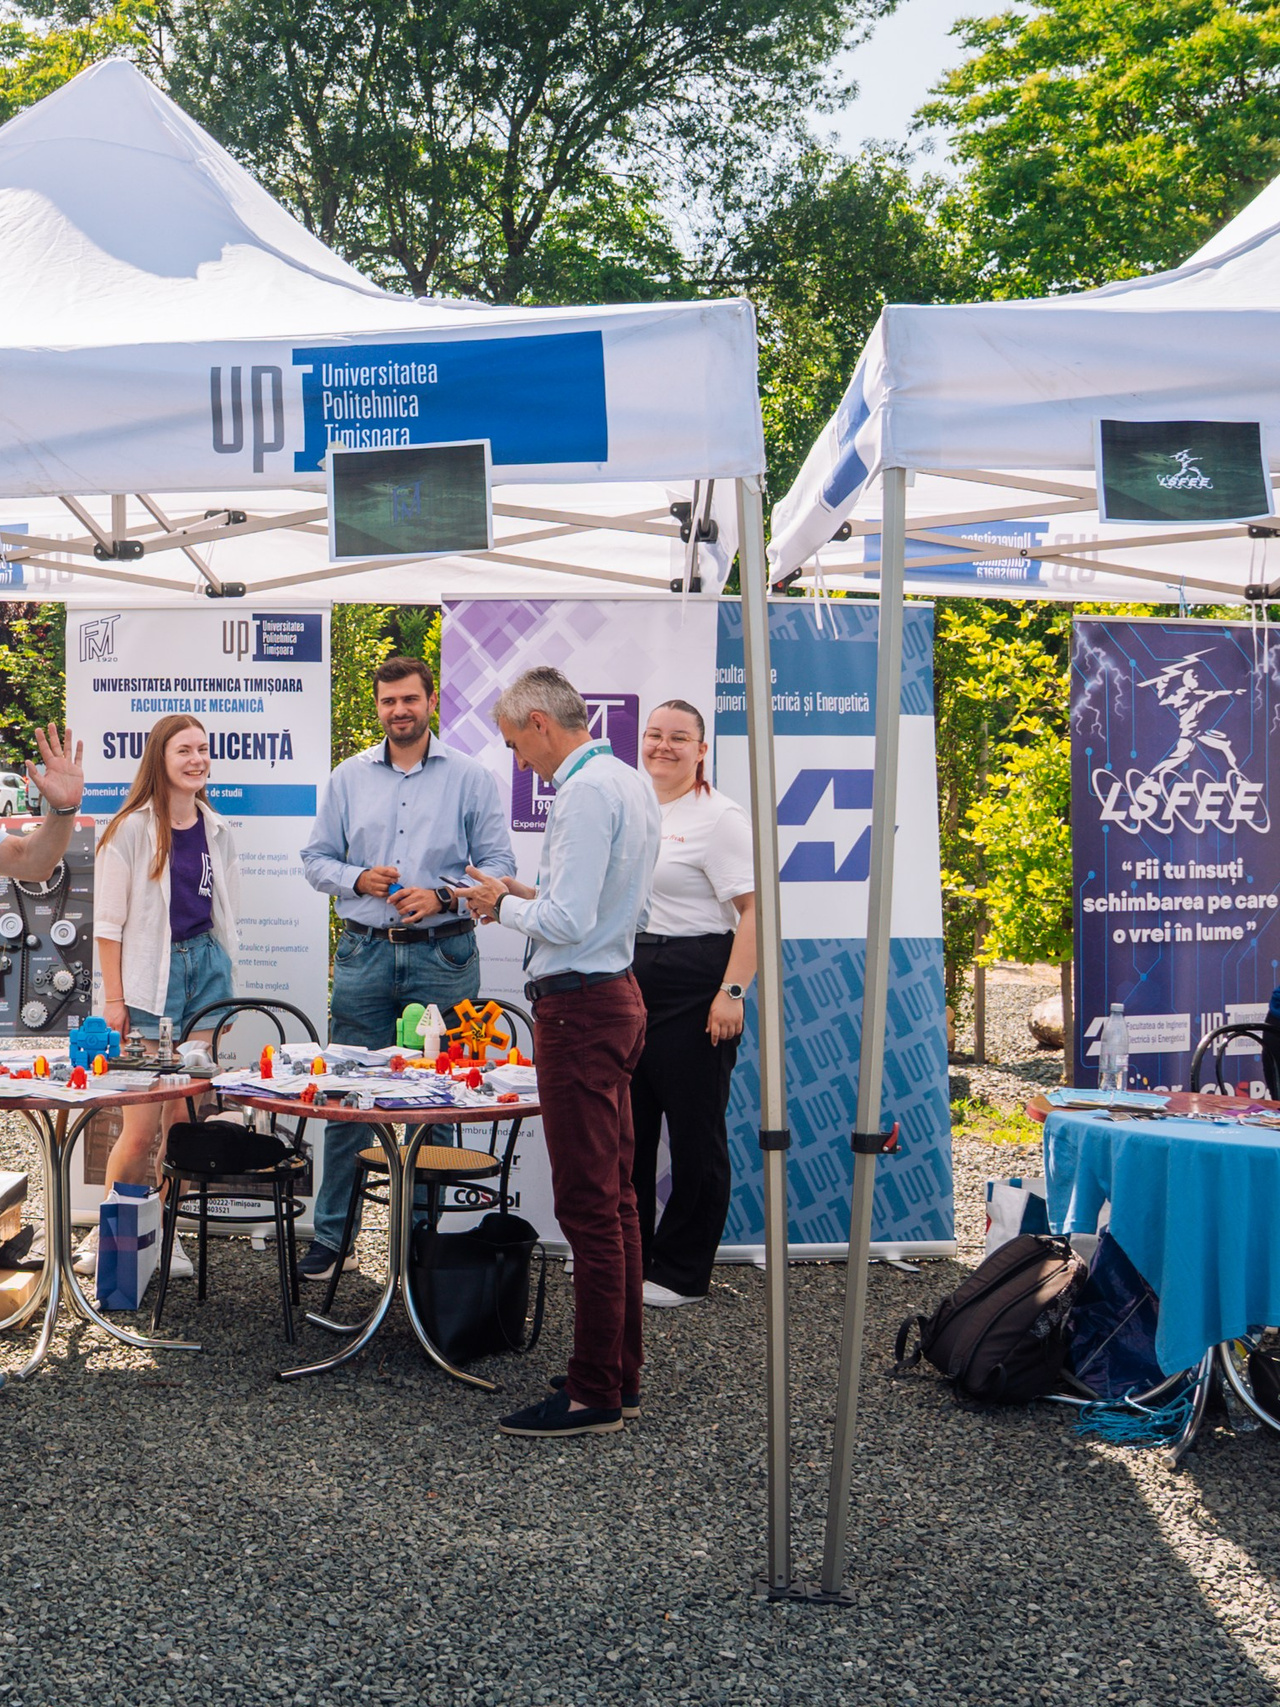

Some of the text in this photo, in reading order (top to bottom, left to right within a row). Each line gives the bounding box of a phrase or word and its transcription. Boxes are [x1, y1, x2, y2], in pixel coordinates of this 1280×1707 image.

[322, 360, 438, 388] Universitatea
[323, 389, 419, 420] Politehnica
[262, 620, 305, 632] Universitatea
[262, 632, 298, 643] Politehnica
[263, 644, 294, 656] Timișoara
[92, 678, 304, 696] UNIVERSITATEA POLITEHNICA TIMIȘOARA
[130, 697, 265, 713] FACULTATEA DE MECANICĂ
[803, 692, 813, 717] și
[816, 691, 870, 714] Energetică
[103, 729, 294, 768] STU LICENȚĂ
[81, 786, 119, 797] Domeniul
[119, 786, 130, 797] de
[210, 788, 220, 798] de
[221, 788, 243, 798] studii
[1096, 778, 1266, 824] LSFEE
[1163, 861, 1186, 880] tu
[1188, 857, 1244, 886] însuți
[1082, 890, 1279, 914] schimbarea pe care
[1112, 929, 1126, 944] o
[1129, 921, 1171, 944] vrei
[1174, 922, 1193, 942] în
[1157, 1022, 1165, 1030] de
